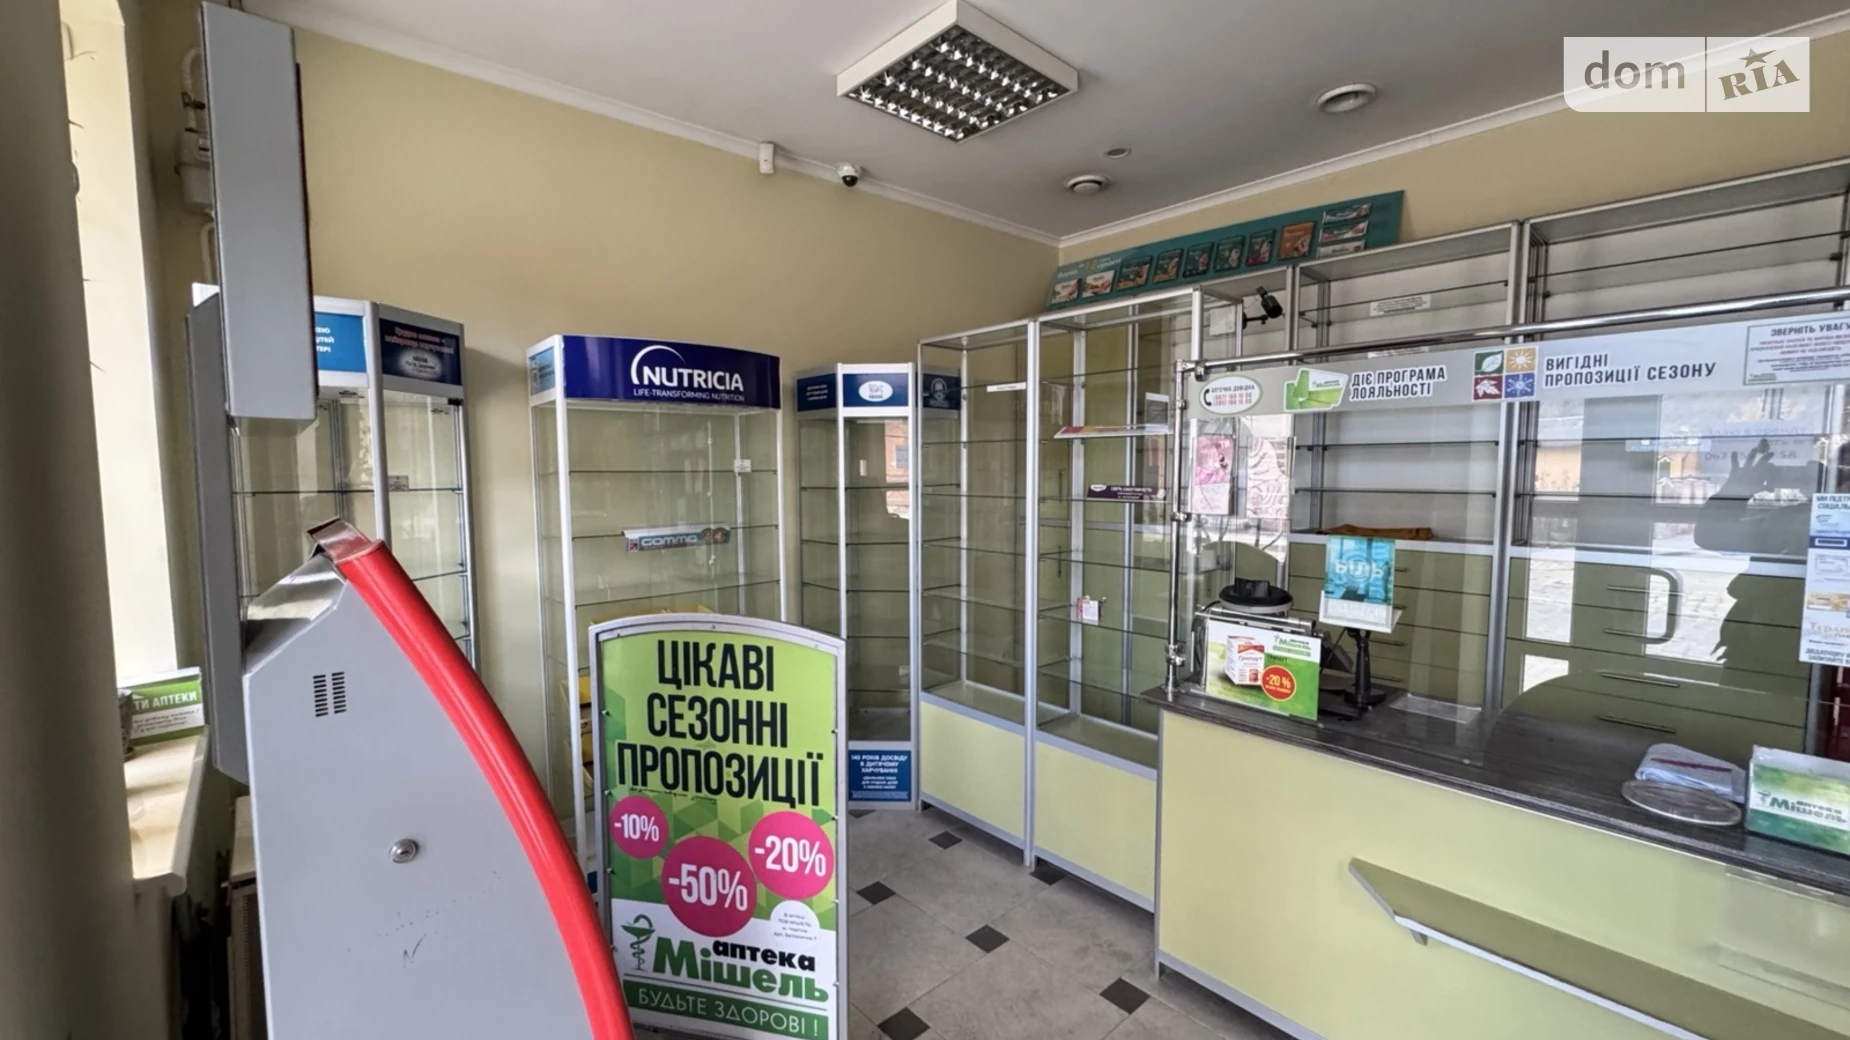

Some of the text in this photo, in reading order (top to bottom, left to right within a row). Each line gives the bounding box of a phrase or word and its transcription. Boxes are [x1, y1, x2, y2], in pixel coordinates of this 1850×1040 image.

[1770, 326, 1816, 337] ЗВЕРНІТЬ
[1352, 366, 1445, 387] ДІЄ ПРОГРАМА
[1545, 362, 1717, 387] ПРОПОЗИЦІЇ СЕЗОНУ
[1546, 354, 1608, 371] ВИГІДНІ
[643, 366, 744, 392] NUTRICIA
[1351, 382, 1431, 400] ЛОЯЛЬНОСТІ
[633, 388, 745, 402] LIFE-TRANSFORMING NUTRITION
[657, 639, 775, 692] ЦІКАВІ
[152, 690, 197, 708] АПТЕКИ
[647, 692, 788, 748] СЕЗОННІ
[617, 741, 824, 809] ПРОПОЗИЦІЇ
[1769, 797, 1847, 824] Мішель
[614, 813, 660, 843] -10%
[754, 835, 827, 877] -20%
[668, 863, 748, 911] -50%
[652, 936, 829, 1003] Мішель
[712, 940, 815, 972] аптека
[638, 988, 819, 1037] БУДЬТЕ ЗДОРОВІ !
